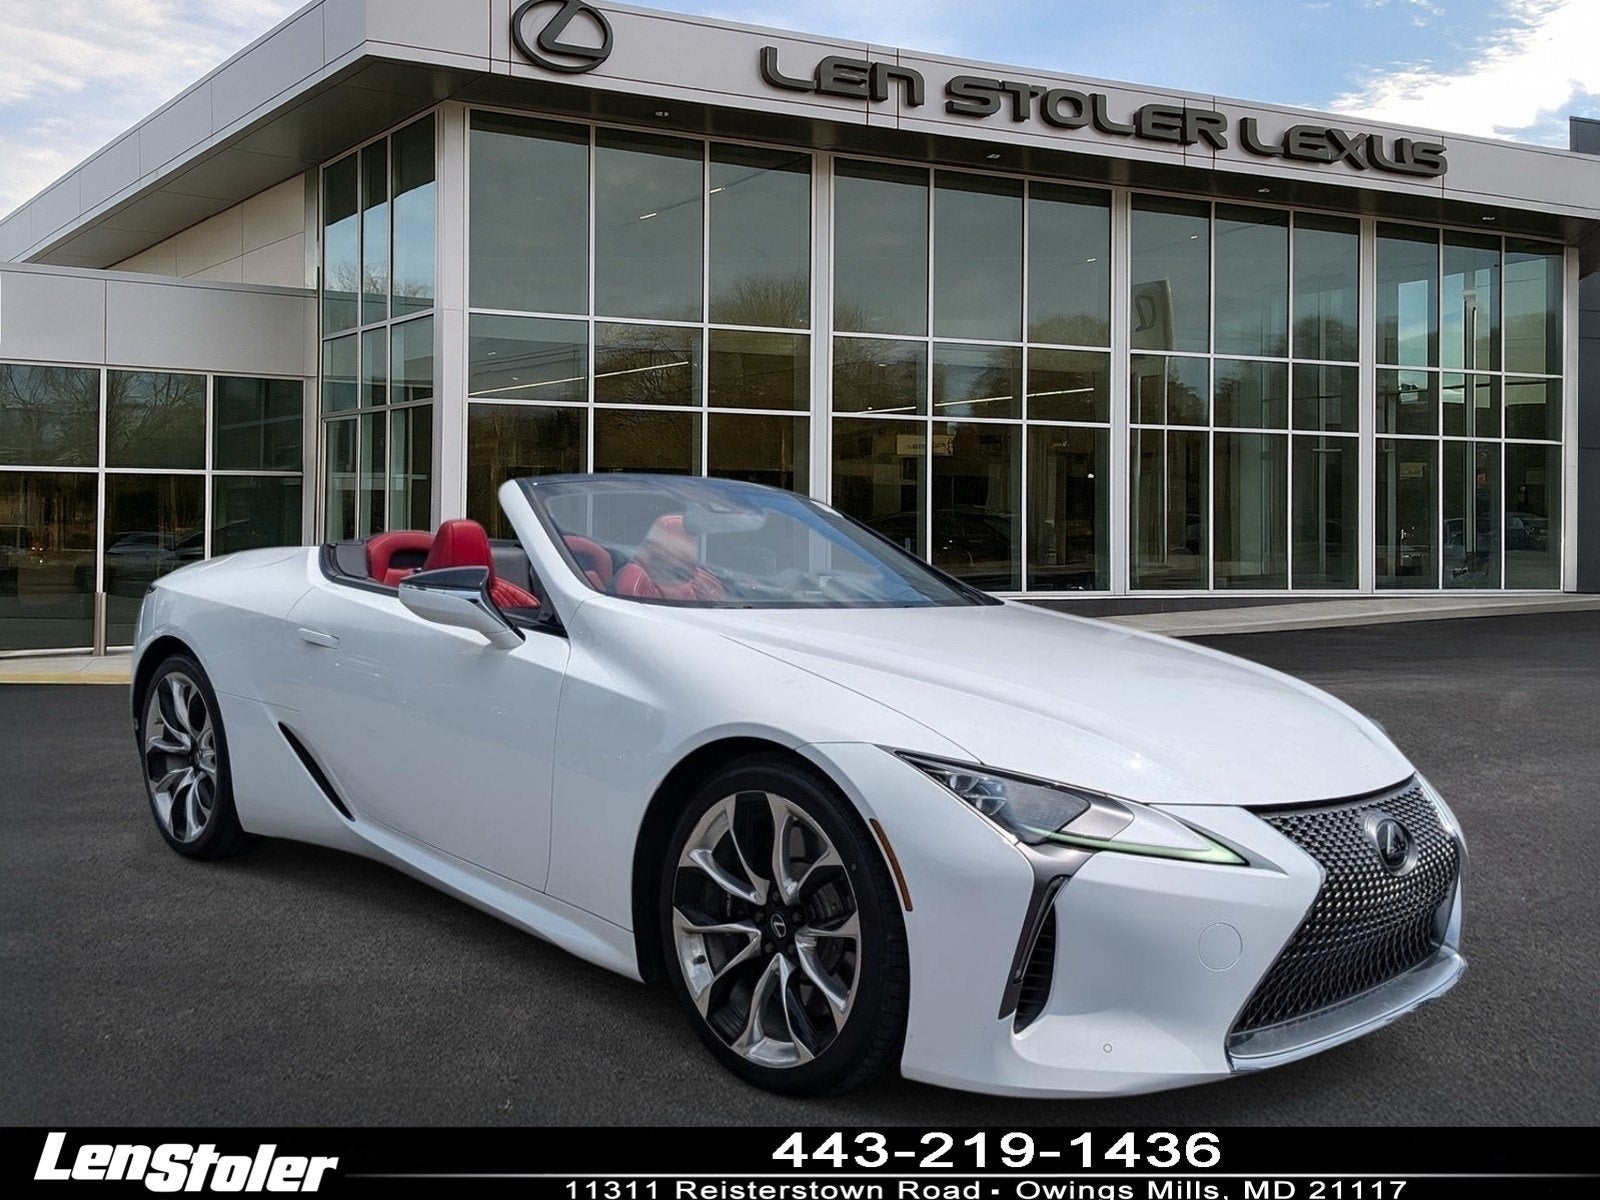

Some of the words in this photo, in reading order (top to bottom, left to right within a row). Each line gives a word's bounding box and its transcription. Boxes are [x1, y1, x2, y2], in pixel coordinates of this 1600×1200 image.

[759, 45, 925, 108] LEN
[945, 75, 1228, 150] STOLER
[1239, 117, 1448, 177] LEXUS
